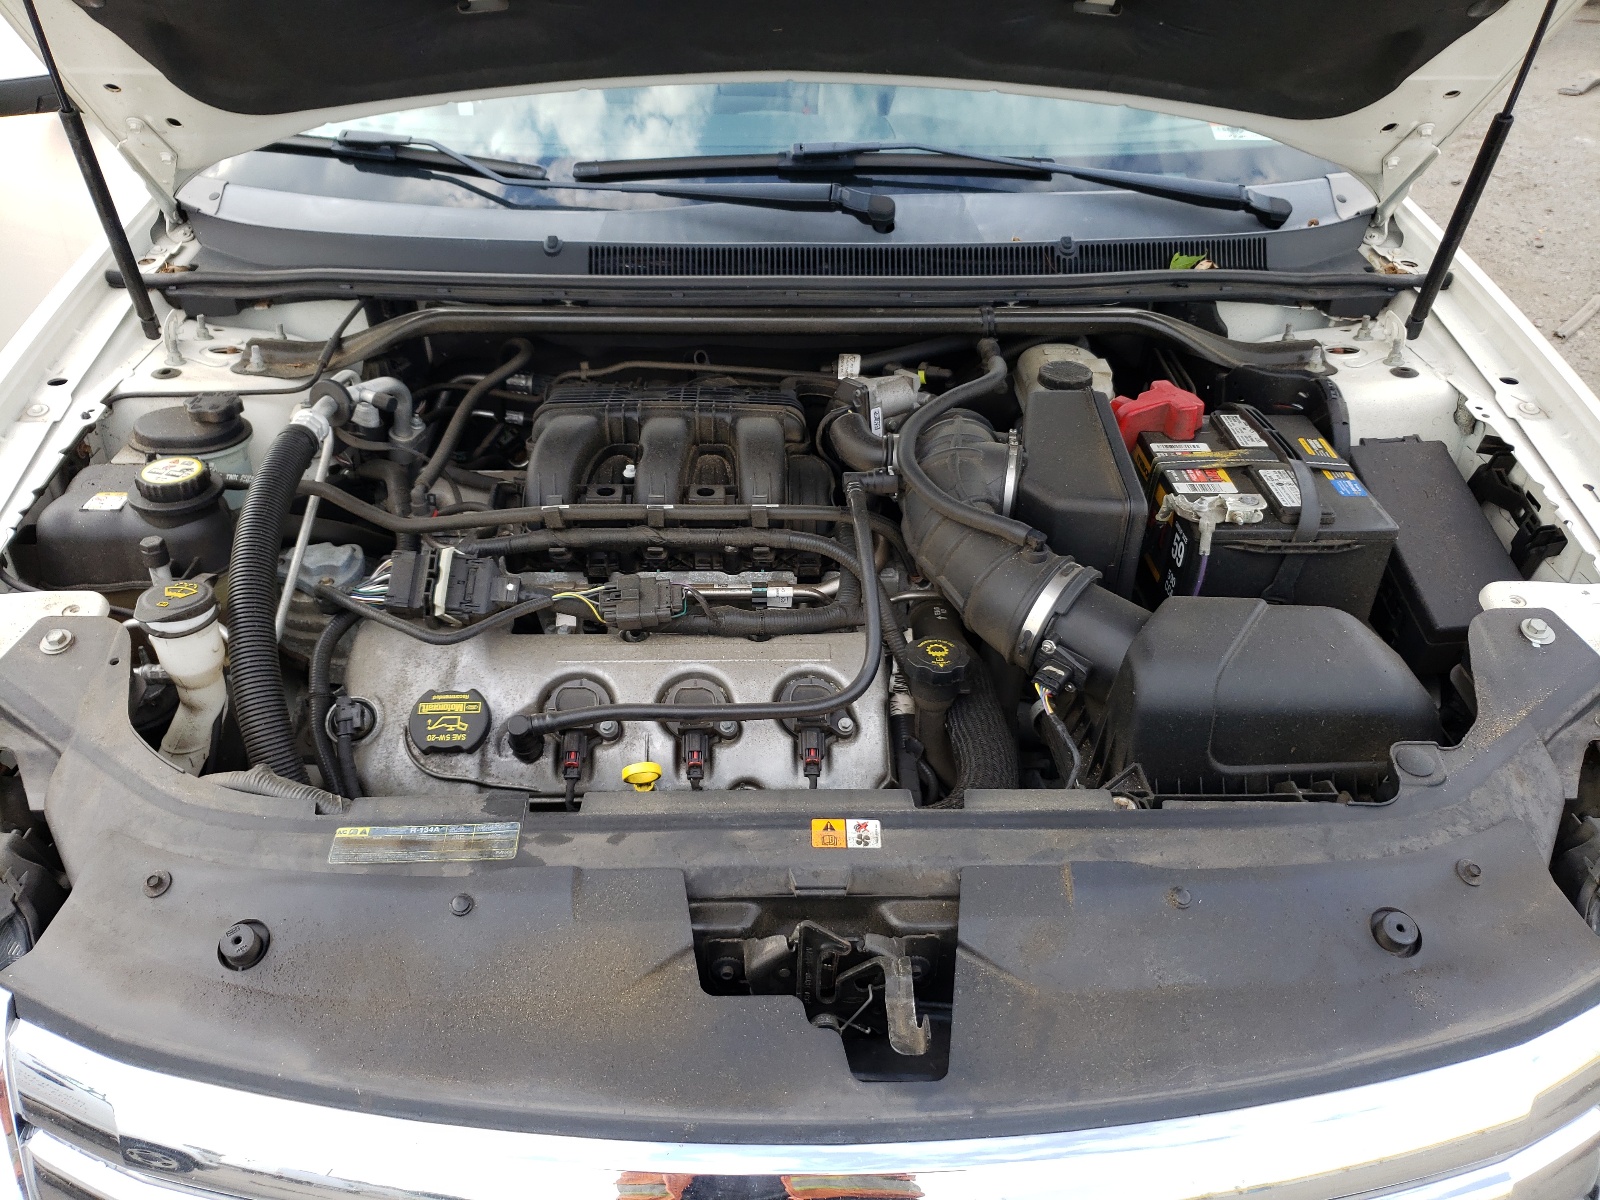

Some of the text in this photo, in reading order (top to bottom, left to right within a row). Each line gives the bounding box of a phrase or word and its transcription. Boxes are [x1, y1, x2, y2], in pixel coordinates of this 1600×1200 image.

[1171, 532, 1185, 568] 59
[421, 703, 463, 712] Motorcraft
[452, 733, 467, 741] SAE
